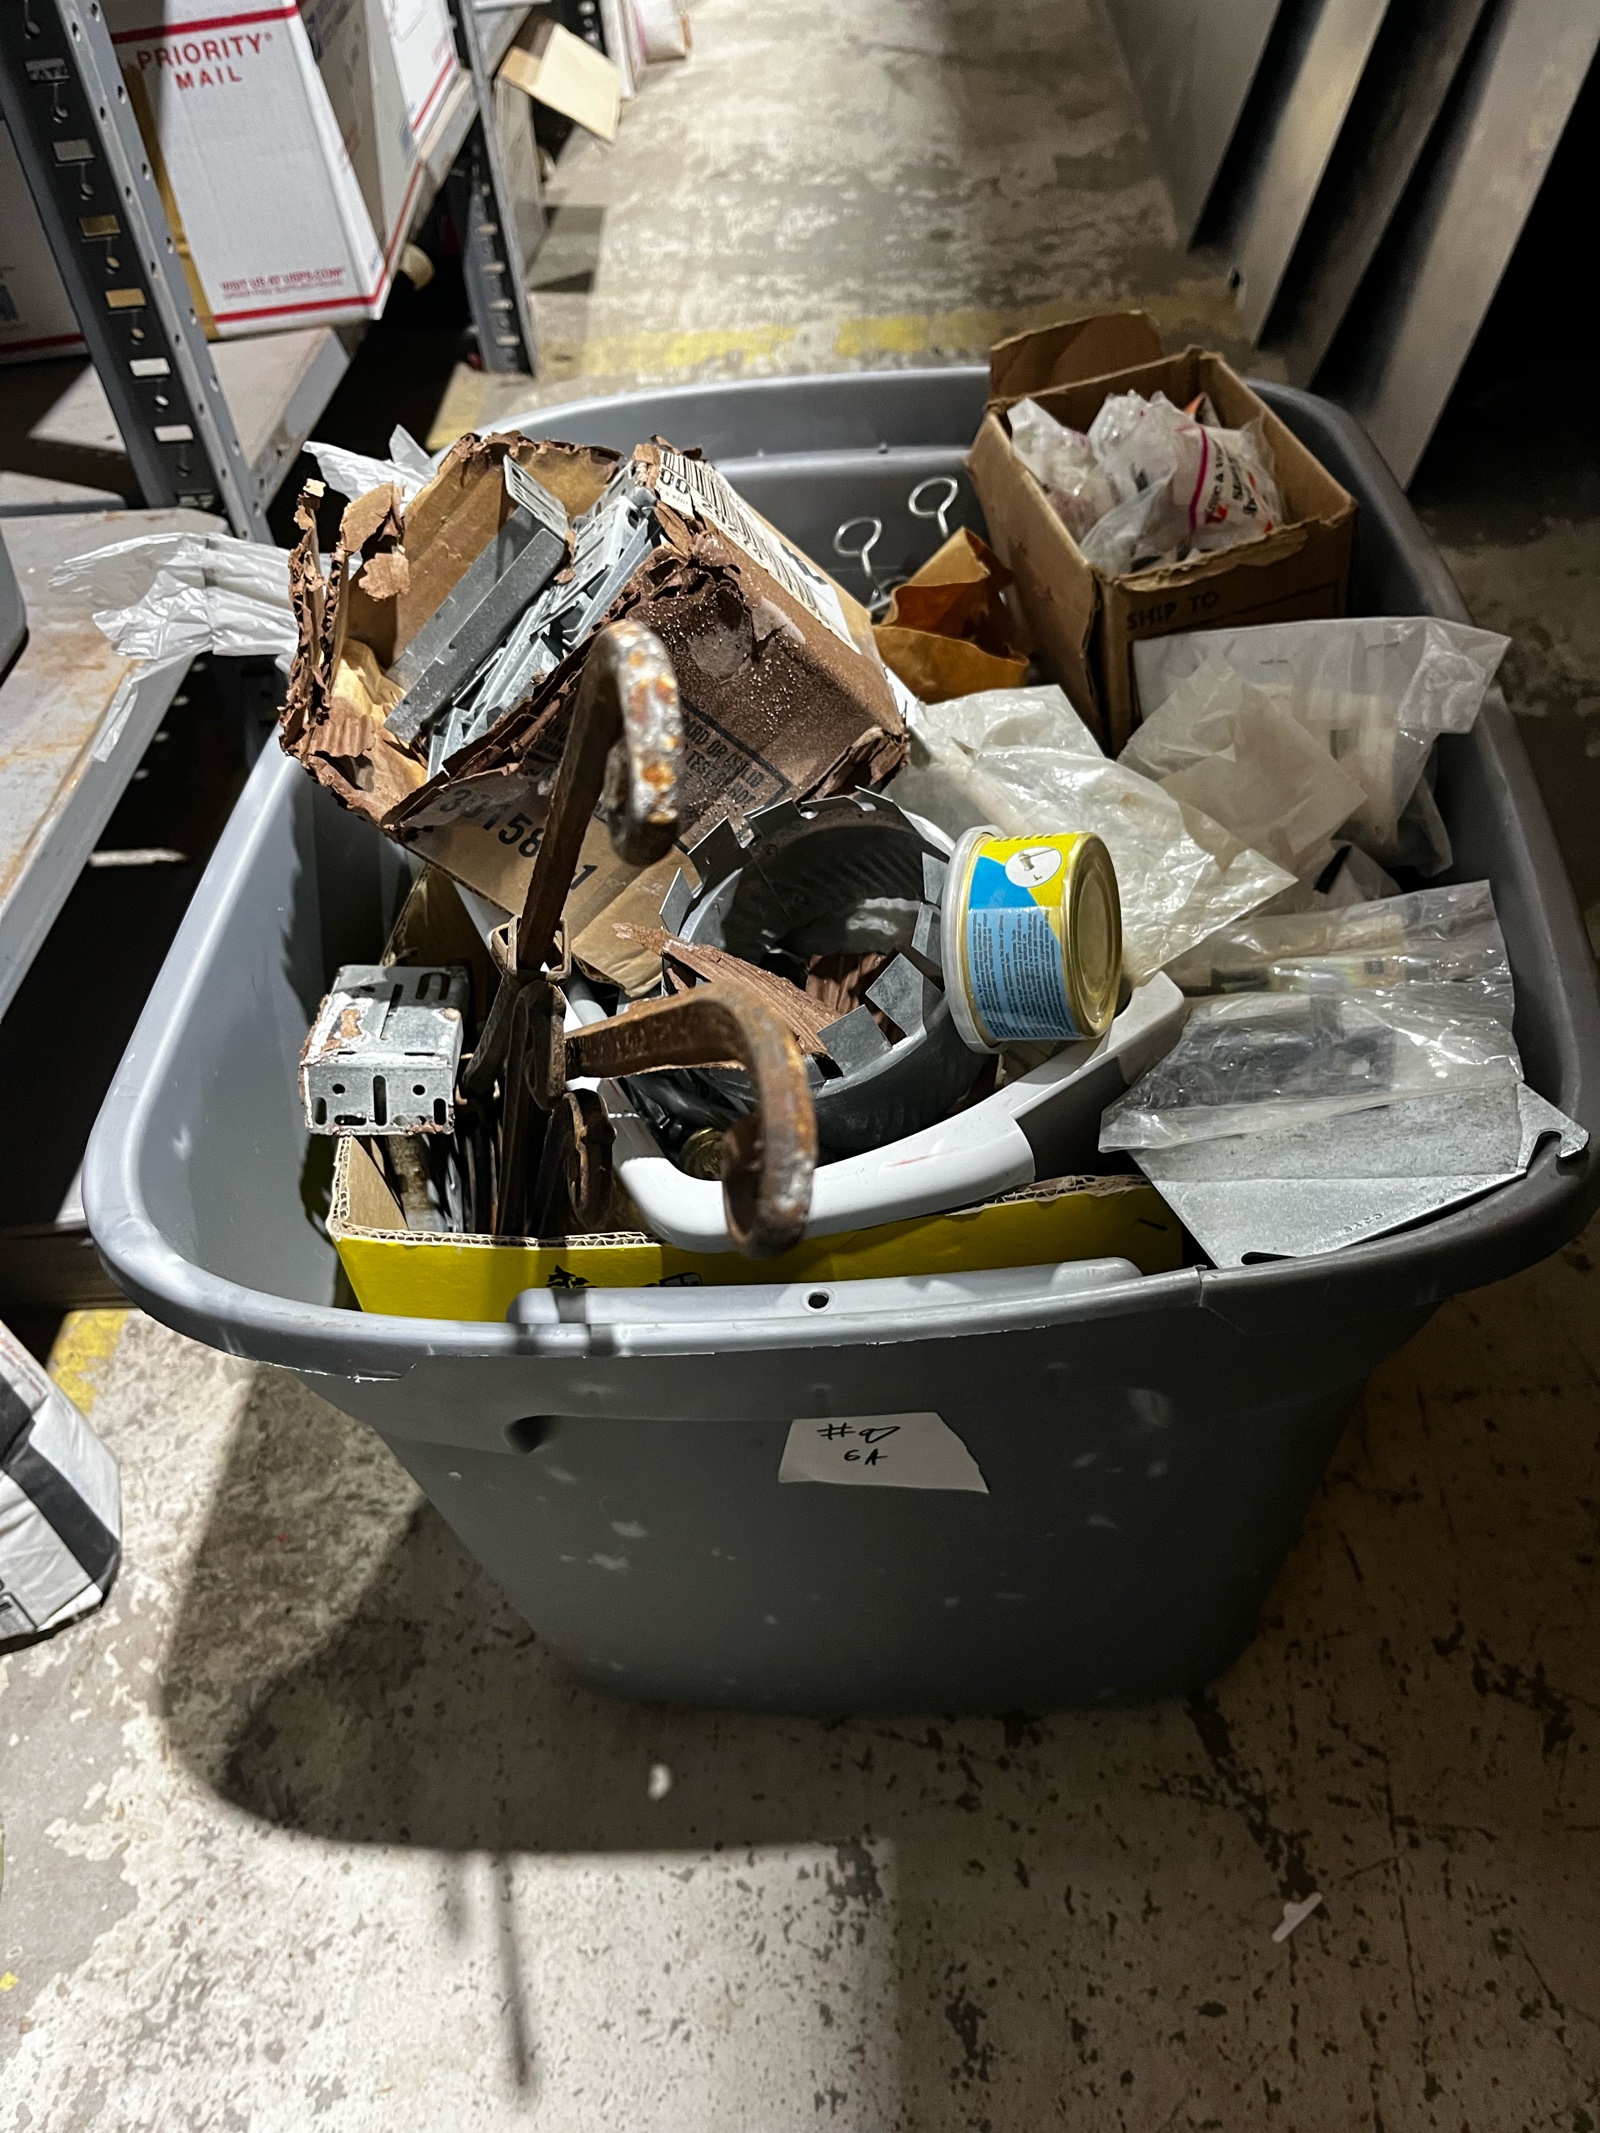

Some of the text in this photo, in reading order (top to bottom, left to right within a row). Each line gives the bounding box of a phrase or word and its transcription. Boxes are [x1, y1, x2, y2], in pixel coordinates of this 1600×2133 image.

[173, 65, 243, 91] MAIL
[1126, 590, 1219, 632] SHIP TO
